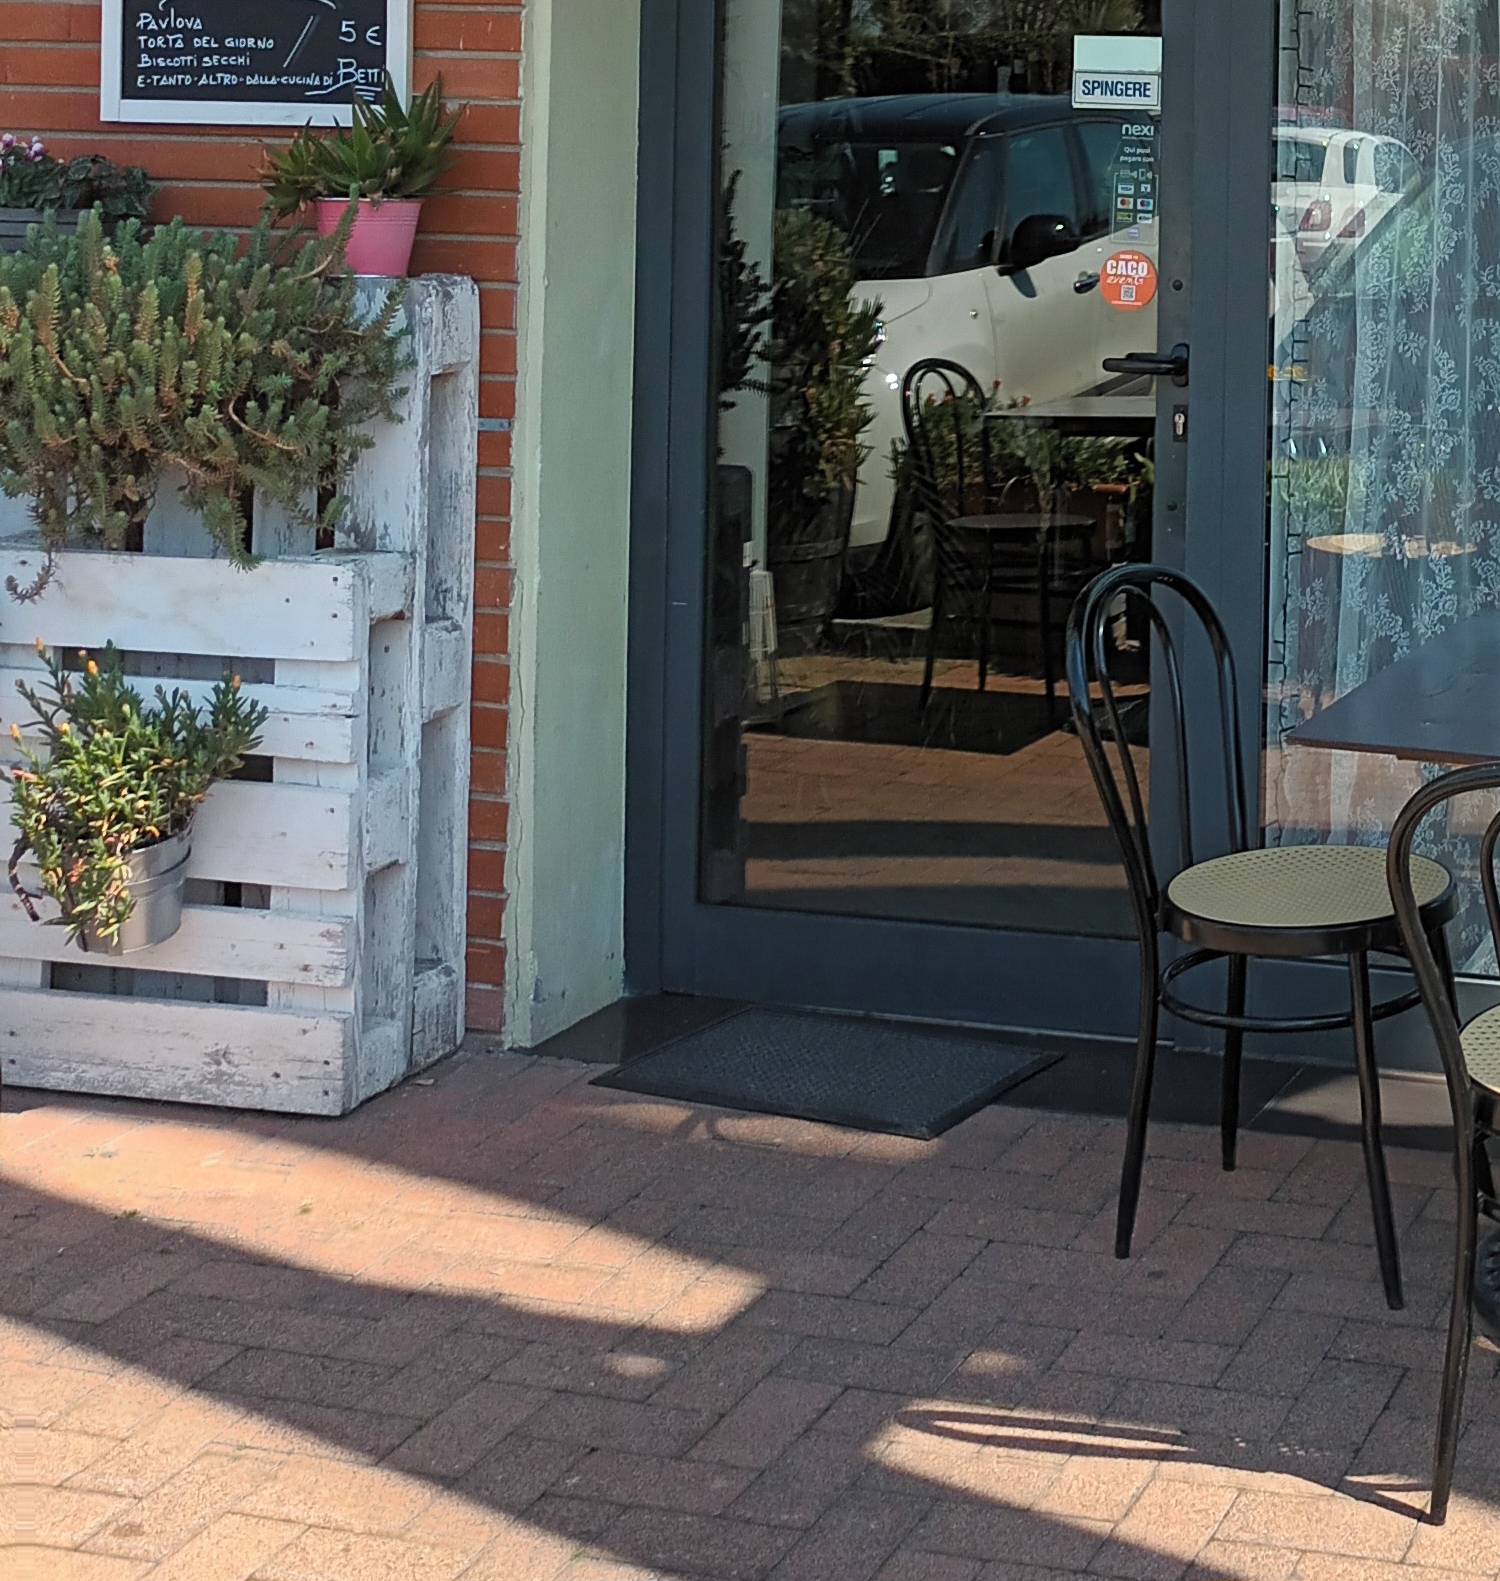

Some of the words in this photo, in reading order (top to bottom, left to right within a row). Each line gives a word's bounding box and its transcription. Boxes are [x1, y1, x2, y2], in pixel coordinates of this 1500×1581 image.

[138, 34, 184, 49] TORTA
[193, 36, 219, 48] DEL
[224, 37, 275, 49] GIORNO
[1081, 79, 1152, 98] SPINGERE
[1121, 123, 1155, 136] nexi
[1106, 259, 1148, 277] CACO
